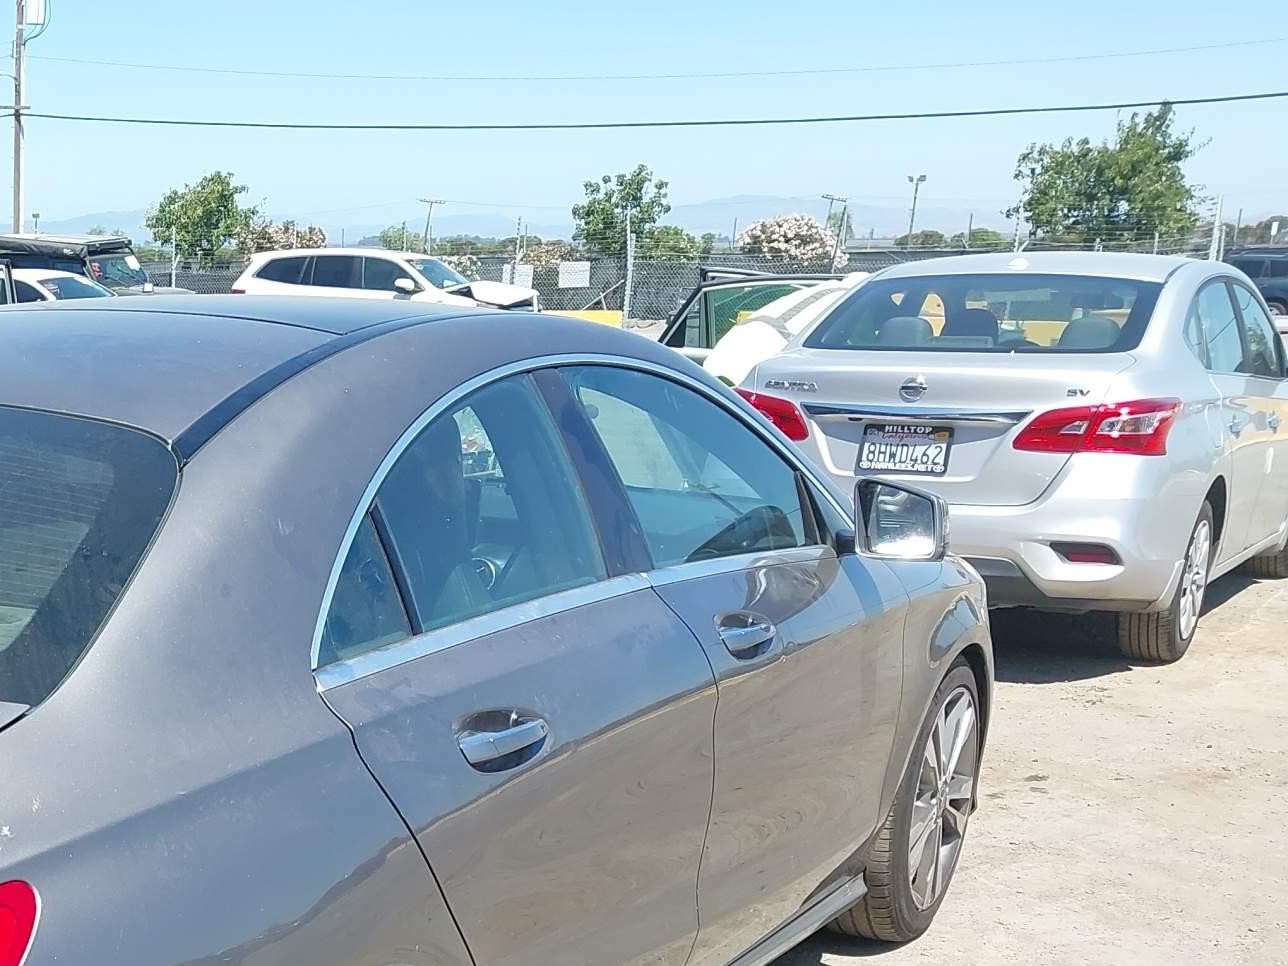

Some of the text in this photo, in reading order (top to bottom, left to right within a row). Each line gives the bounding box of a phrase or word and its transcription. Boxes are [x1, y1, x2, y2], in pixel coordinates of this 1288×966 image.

[1066, 388, 1092, 397] SV
[884, 425, 933, 434] HILLTOP
[866, 442, 943, 466] 8HWD462
